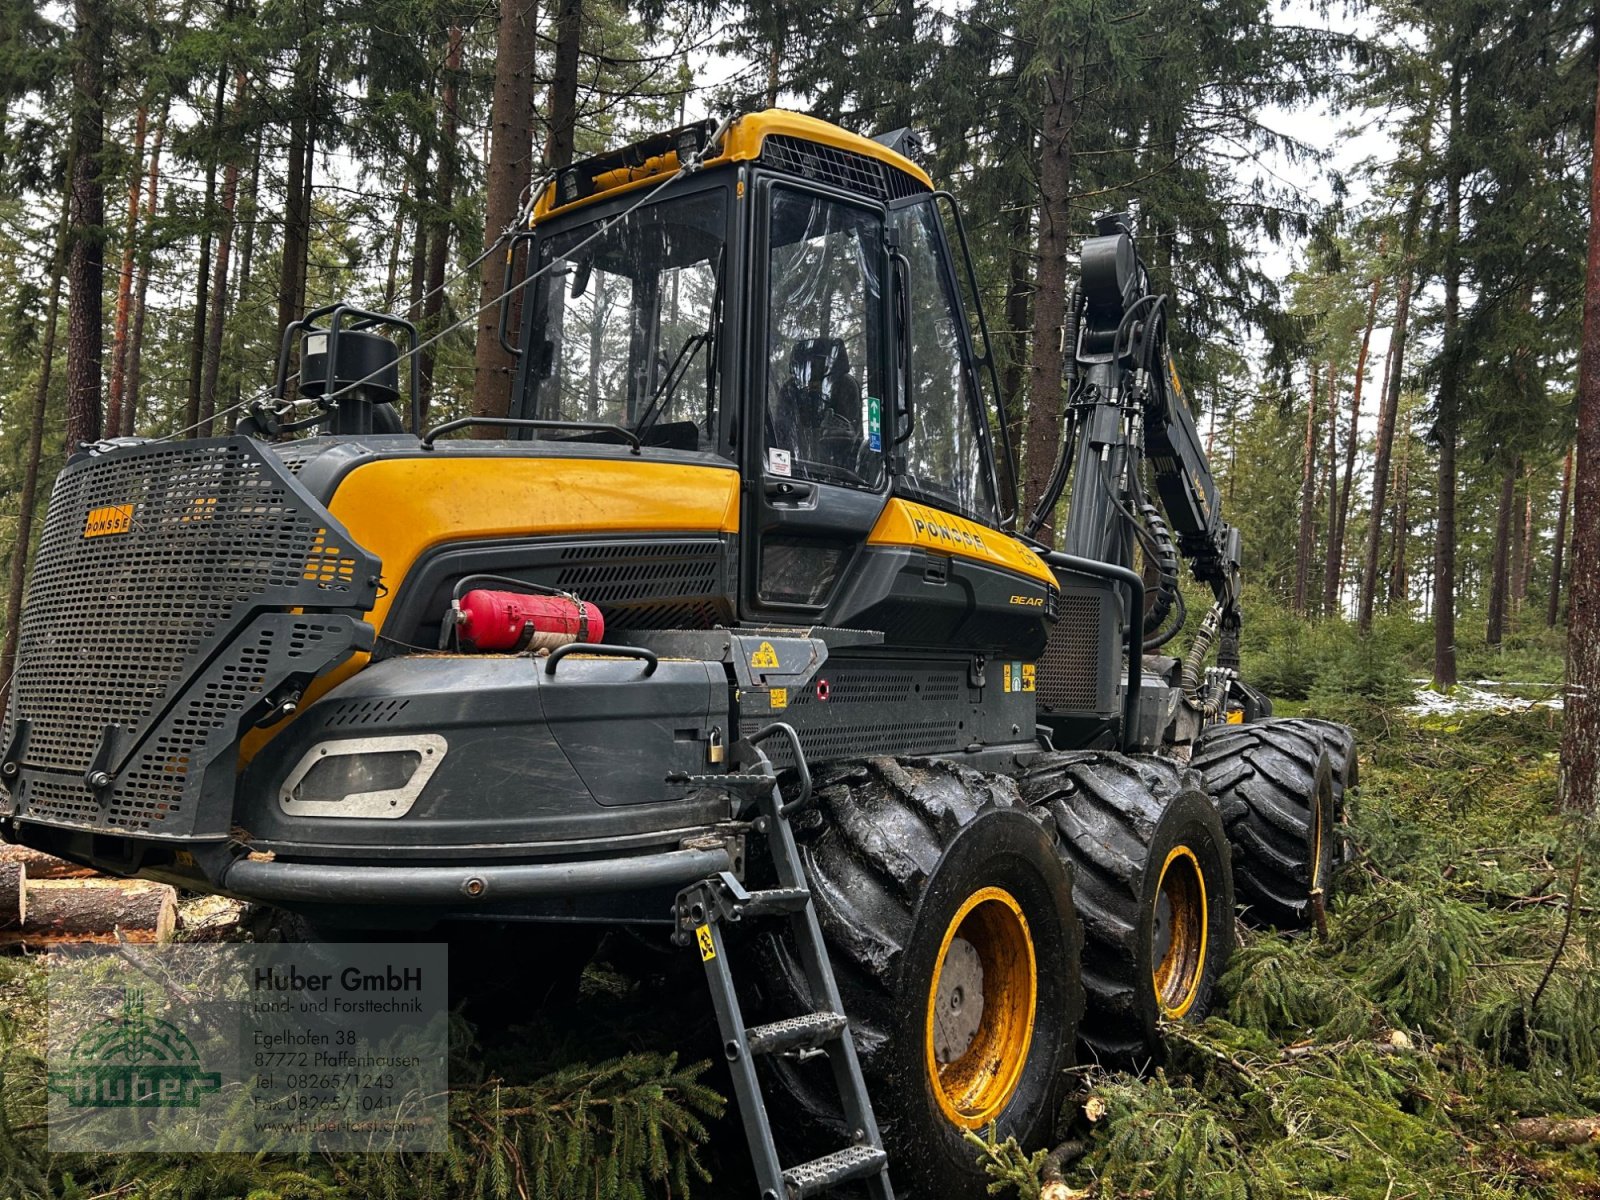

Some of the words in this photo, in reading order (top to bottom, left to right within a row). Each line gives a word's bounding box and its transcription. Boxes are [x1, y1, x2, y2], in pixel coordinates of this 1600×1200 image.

[86, 518, 128, 532] PONSSE
[914, 518, 984, 549] PONSSE
[1009, 595, 1044, 607] BEAR
